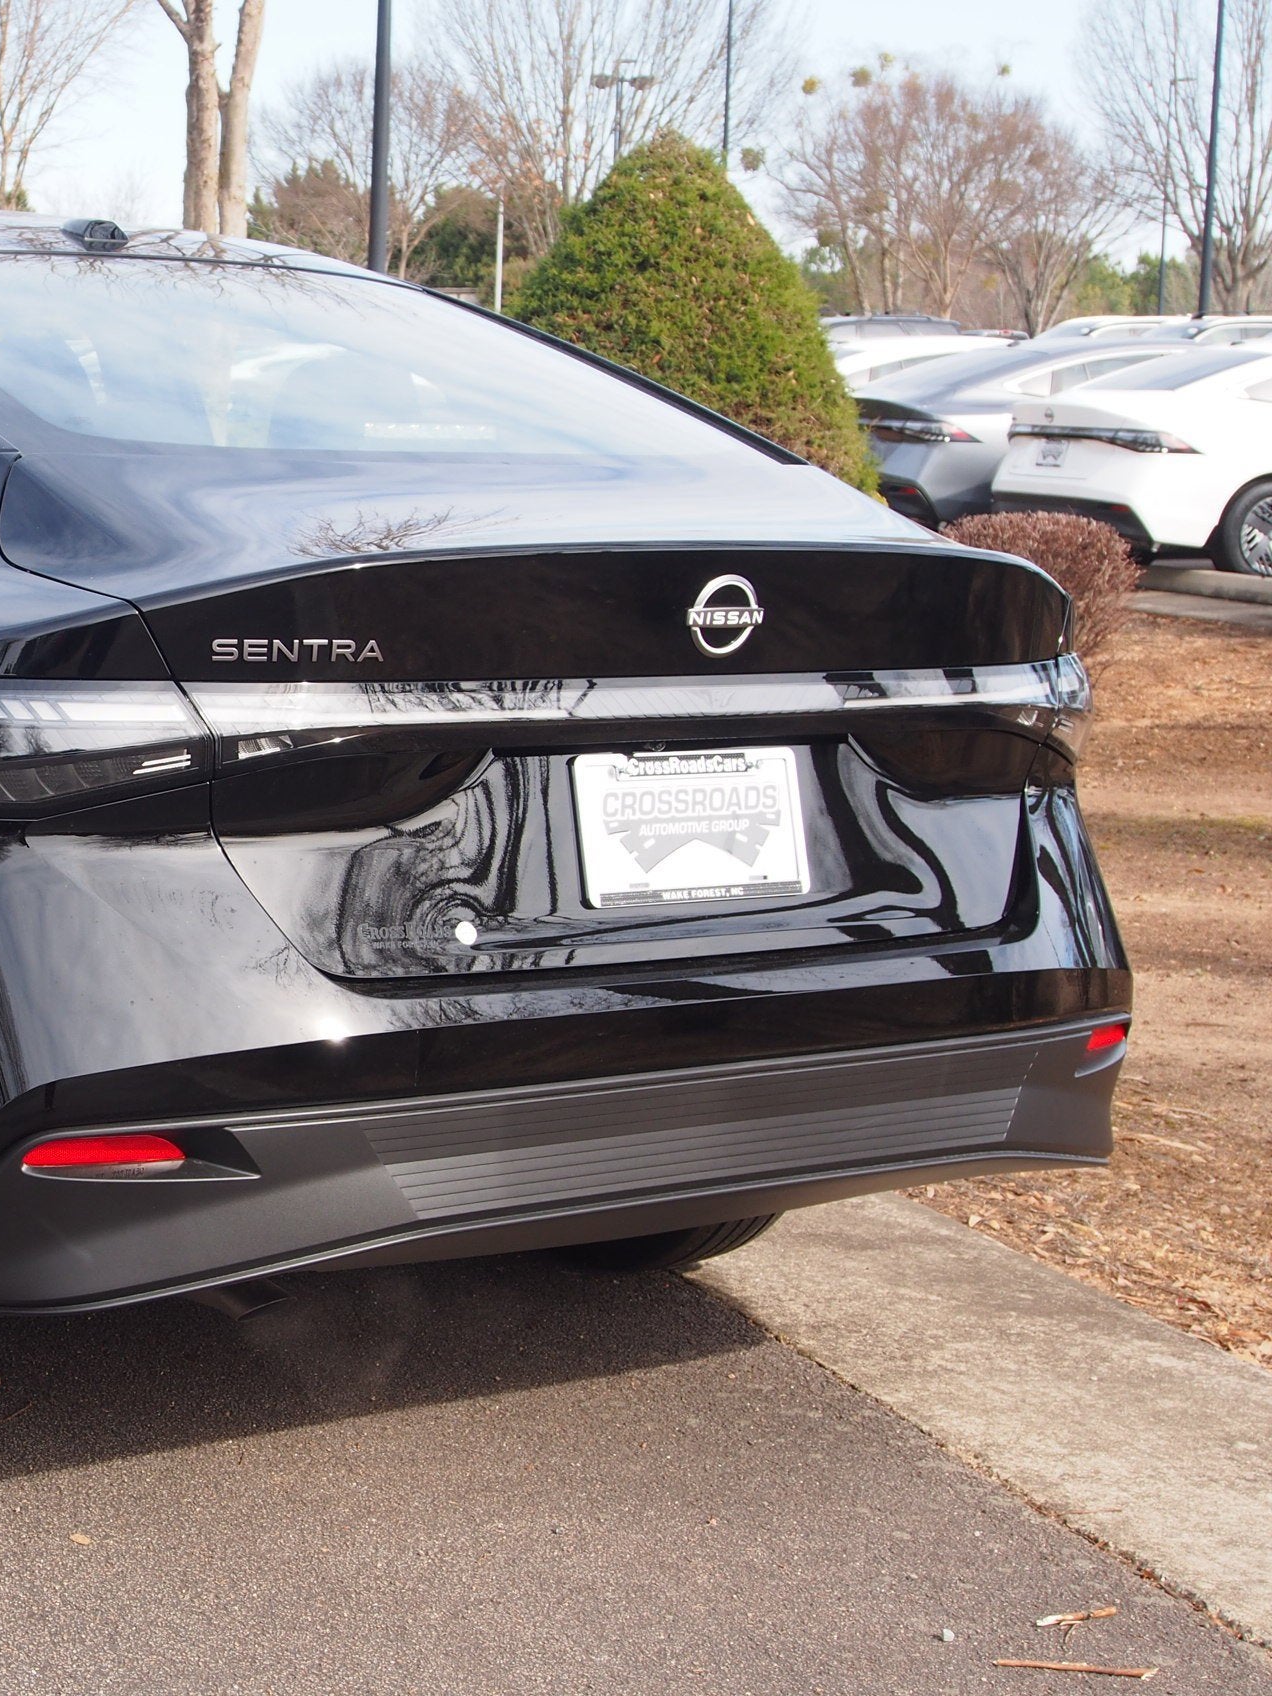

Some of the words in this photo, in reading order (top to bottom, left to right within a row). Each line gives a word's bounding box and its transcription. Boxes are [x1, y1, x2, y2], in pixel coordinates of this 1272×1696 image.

[688, 608, 764, 626] NISSAN
[211, 638, 384, 663] SENTRA
[602, 784, 777, 818] CROSSROADS
[639, 820, 708, 836] AUTOMOTIVE
[711, 818, 750, 832] GROUP
[662, 890, 689, 900] WAKE
[731, 886, 744, 896] NC
